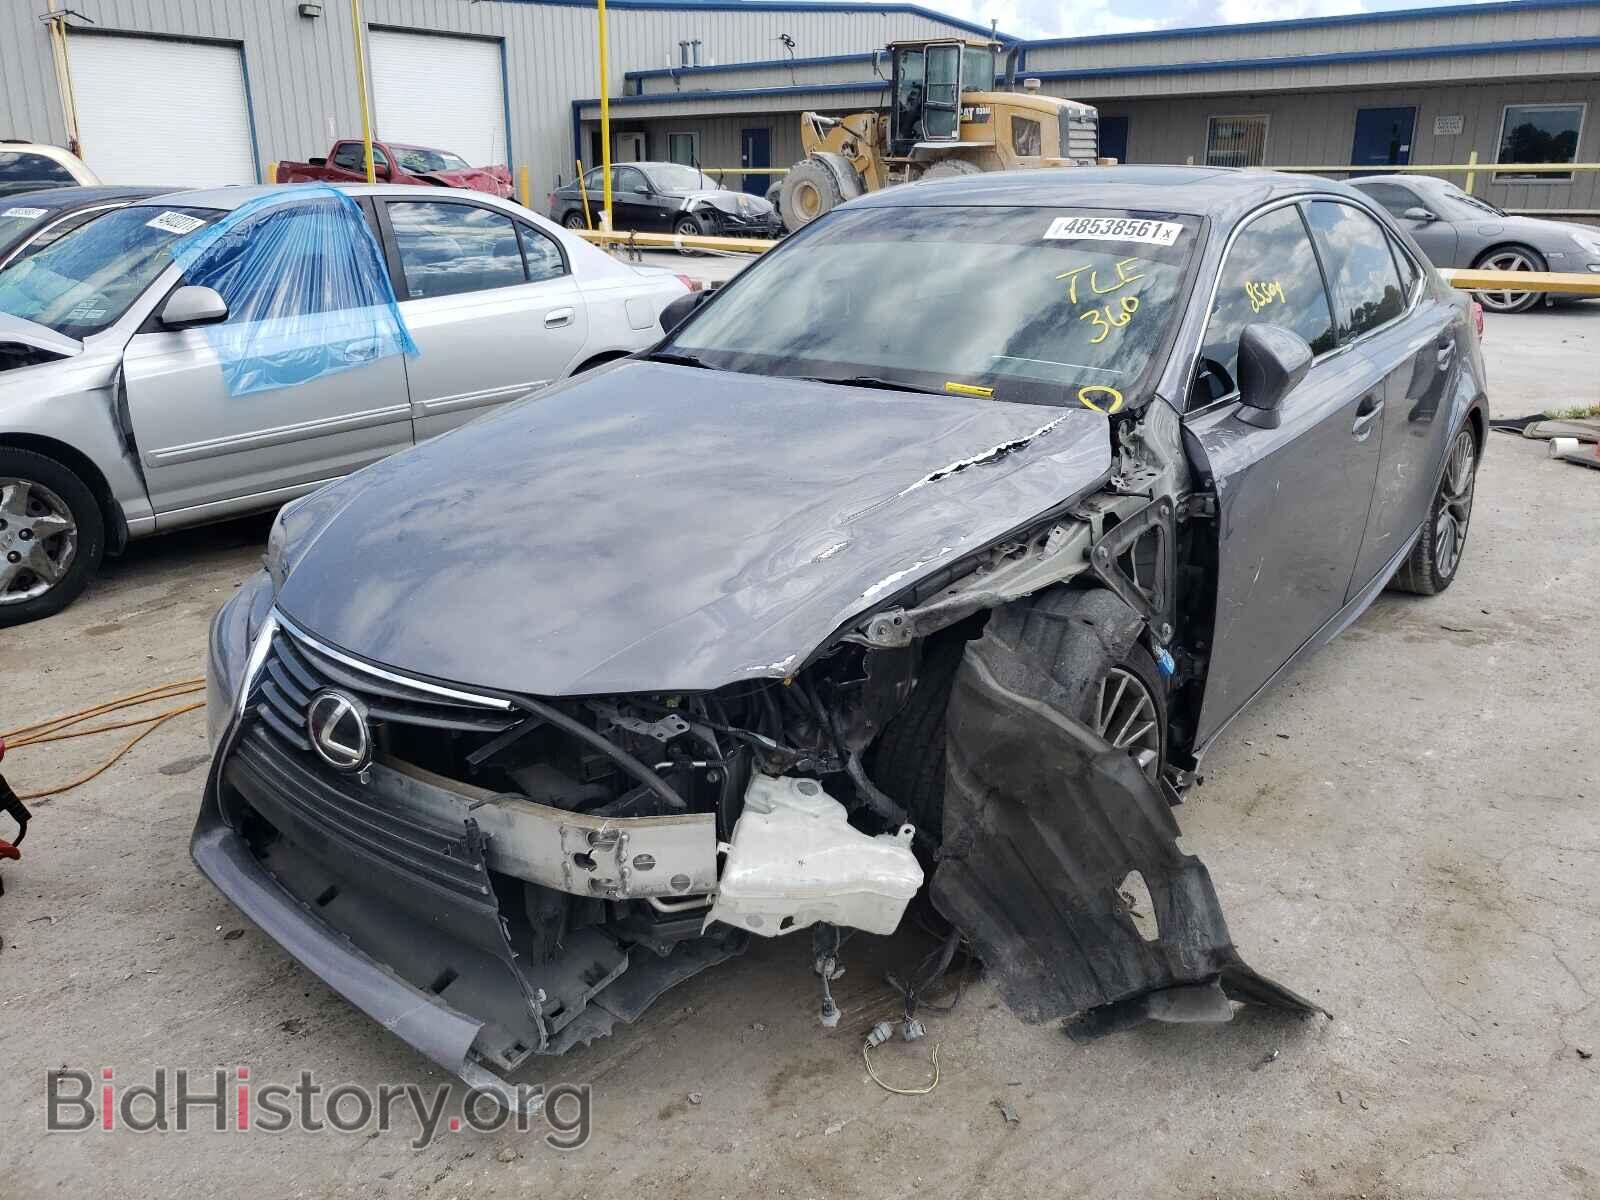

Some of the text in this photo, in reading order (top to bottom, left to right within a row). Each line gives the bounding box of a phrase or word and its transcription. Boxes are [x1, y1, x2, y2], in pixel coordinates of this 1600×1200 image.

[959, 107, 974, 121] AT
[1064, 218, 1161, 238] 48538561
[1080, 297, 1139, 343] 360
